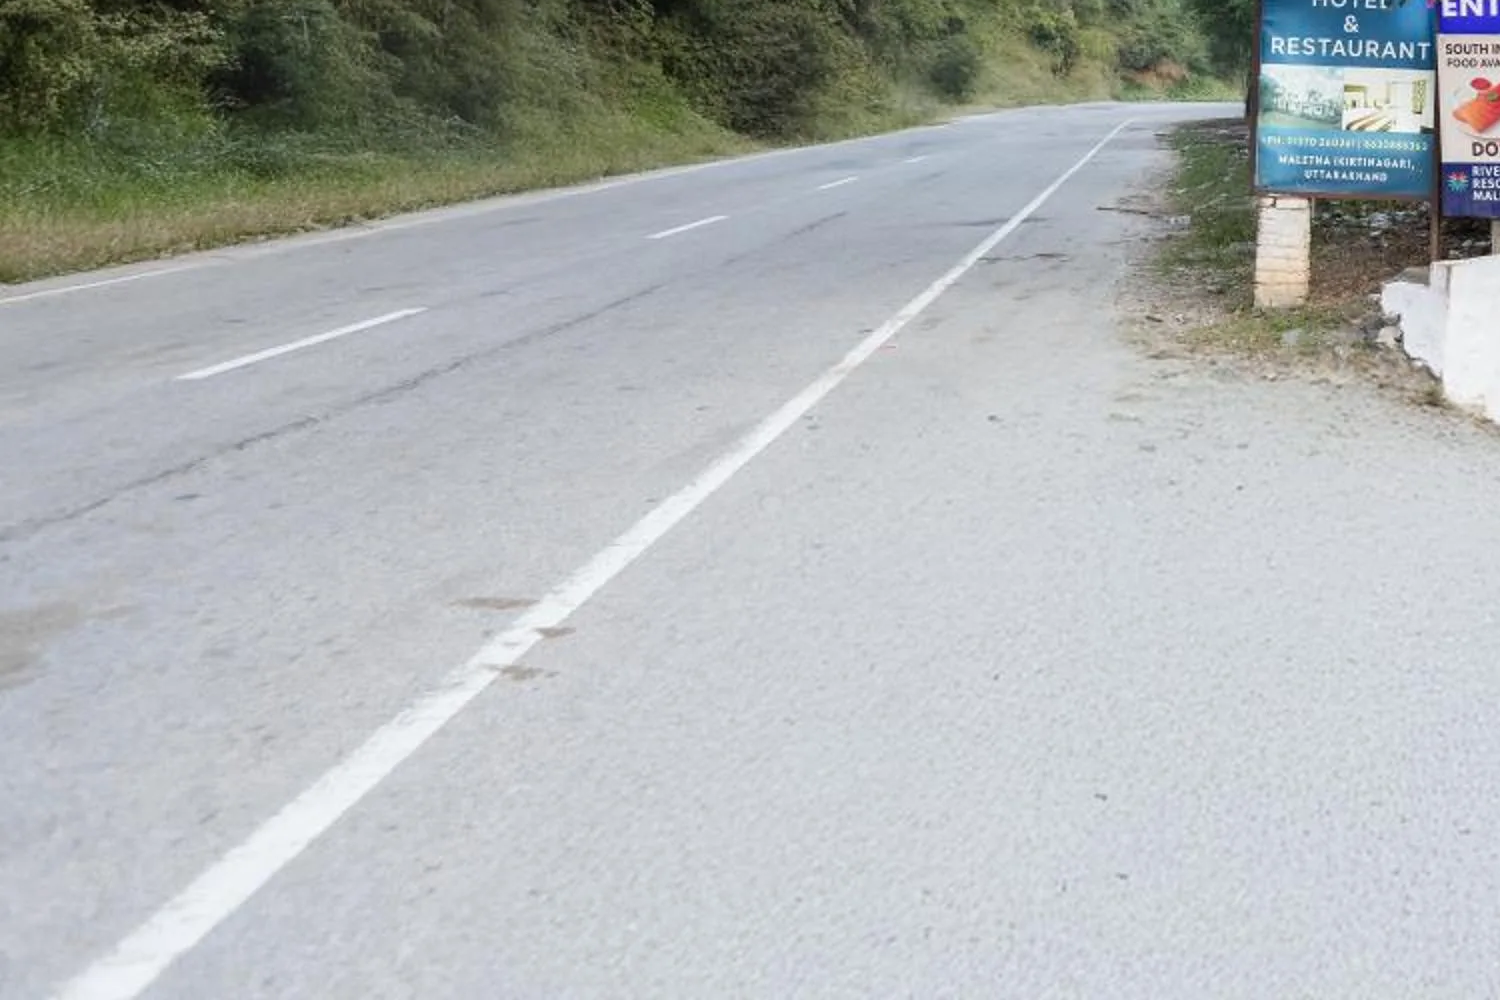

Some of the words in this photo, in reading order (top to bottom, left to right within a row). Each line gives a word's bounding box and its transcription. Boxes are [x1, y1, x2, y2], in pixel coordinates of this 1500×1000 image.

[1343, 15, 1359, 33] &
[1271, 37, 1431, 60] RESTAURANT
[1445, 43, 1488, 55] SOUTH
[1447, 57, 1477, 68] FOOD
[1279, 155, 1330, 166] MALETHA
